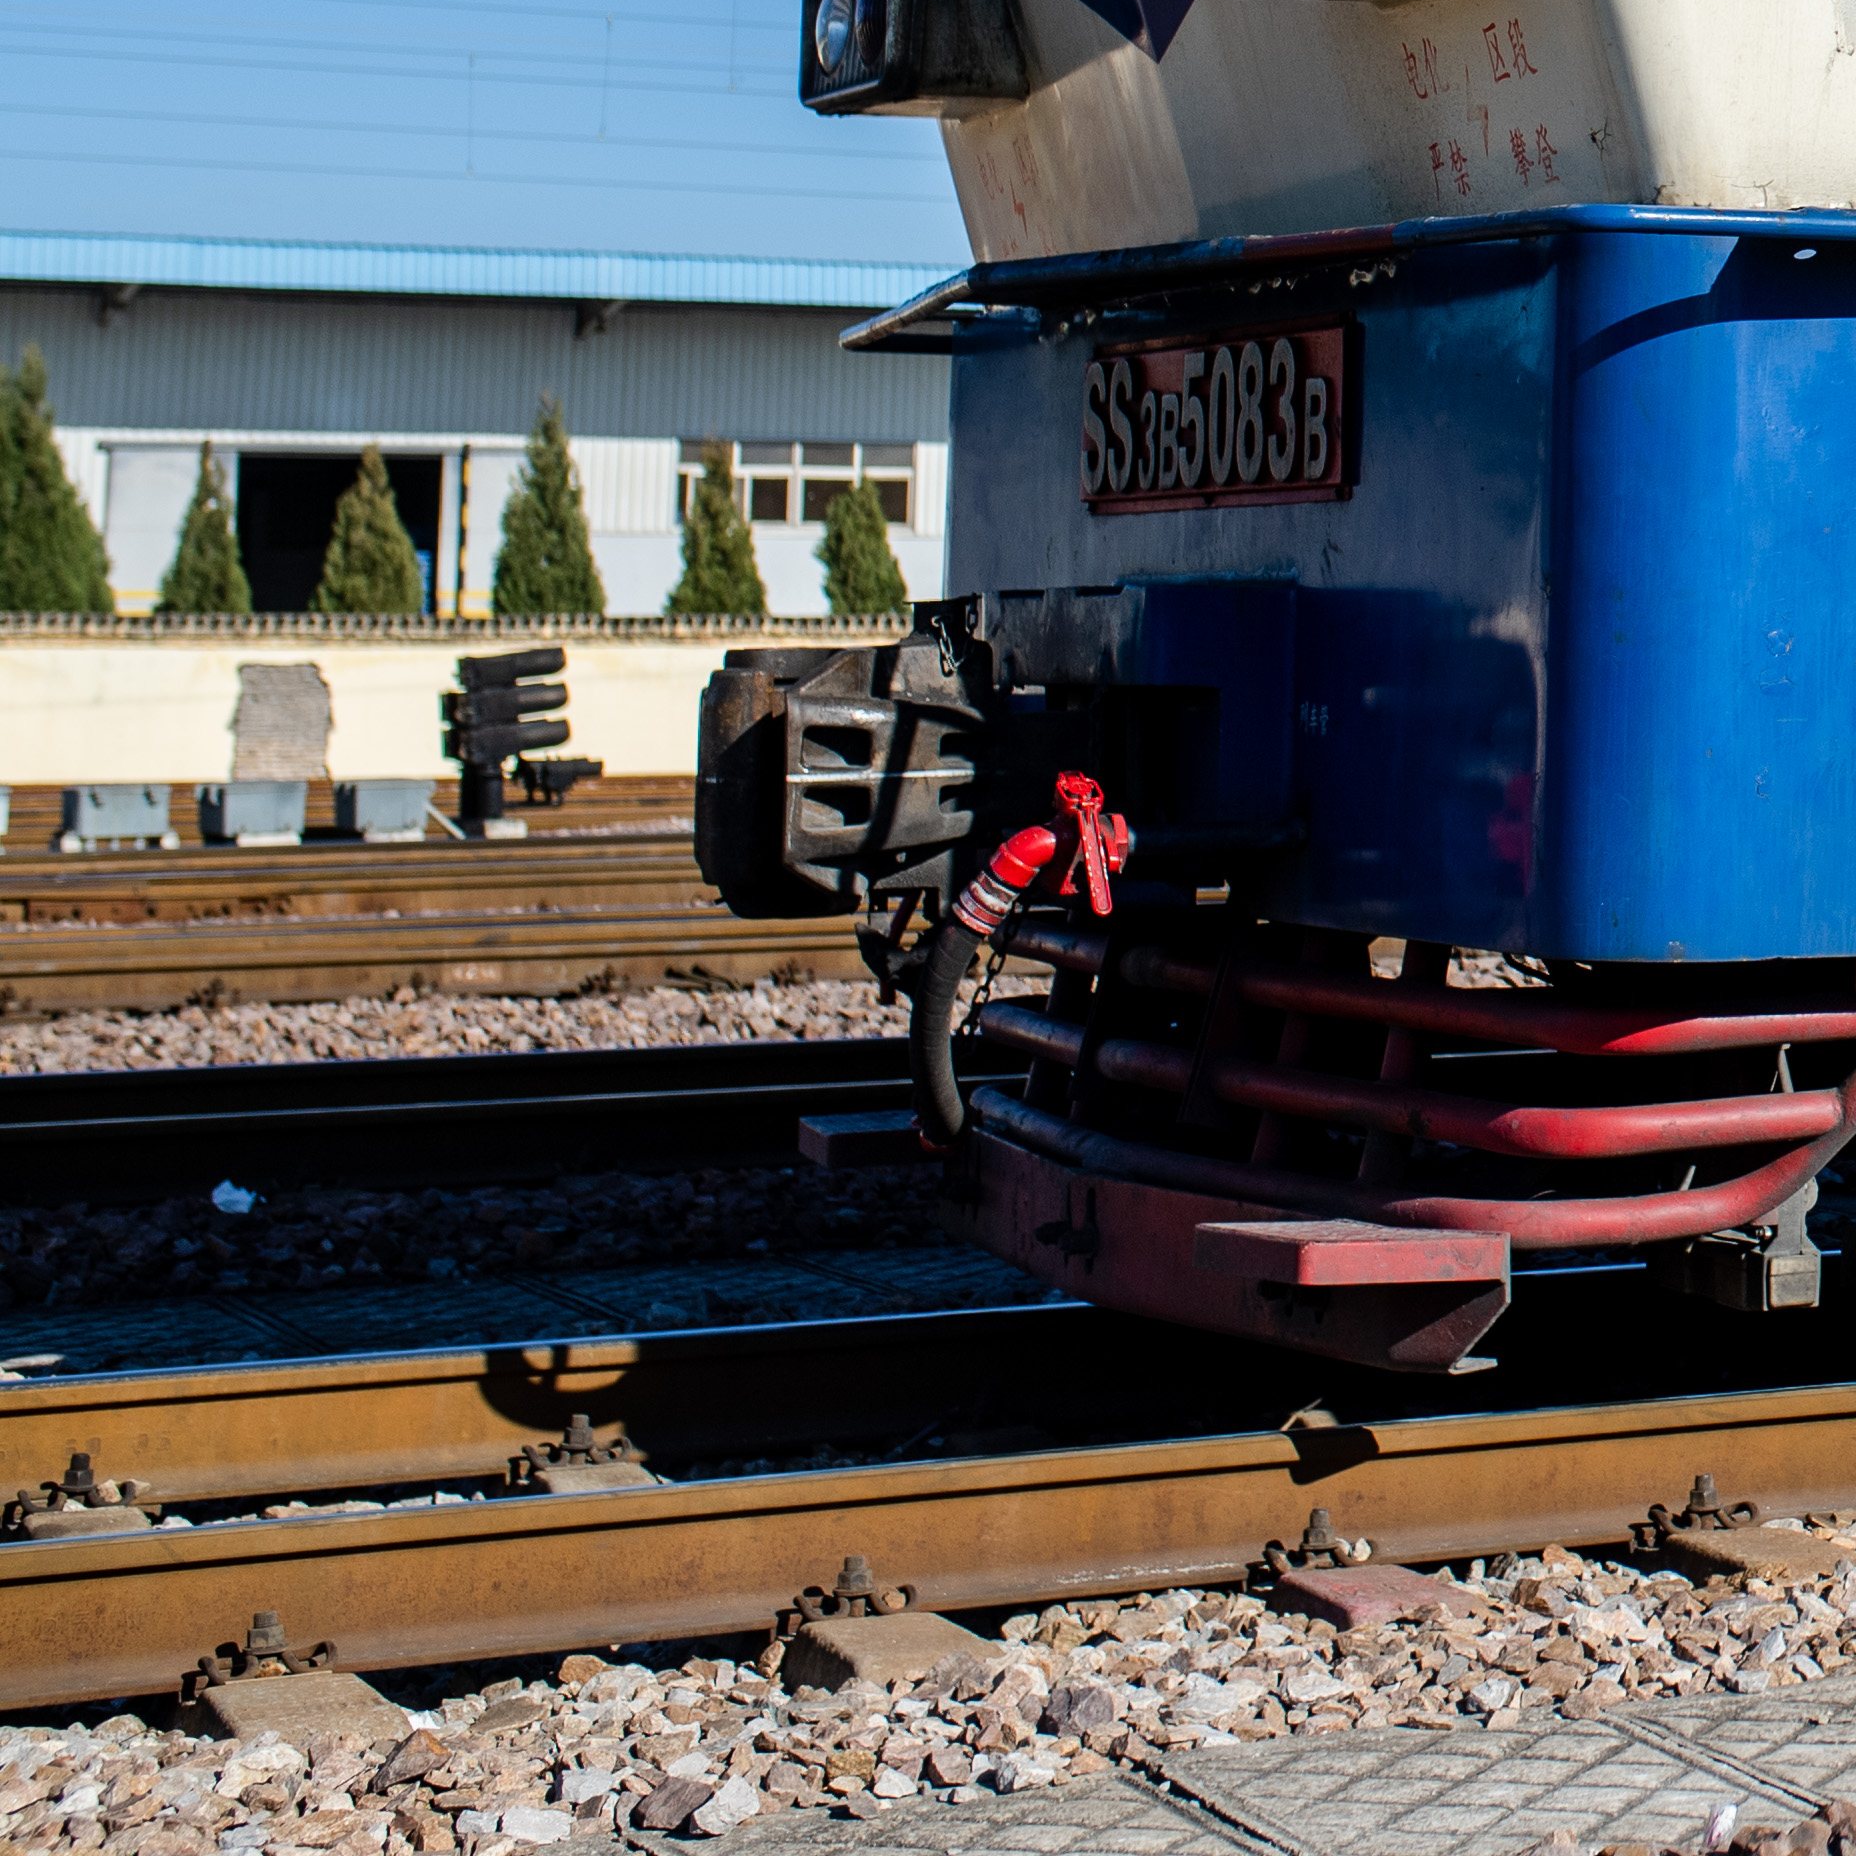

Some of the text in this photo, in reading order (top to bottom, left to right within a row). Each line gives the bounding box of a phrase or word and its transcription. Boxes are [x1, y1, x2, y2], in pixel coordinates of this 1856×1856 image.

[1402, 18, 1538, 99] 电化 区段
[1428, 138, 1471, 201] 严禁
[1080, 337, 1327, 495] SS3B5083B
